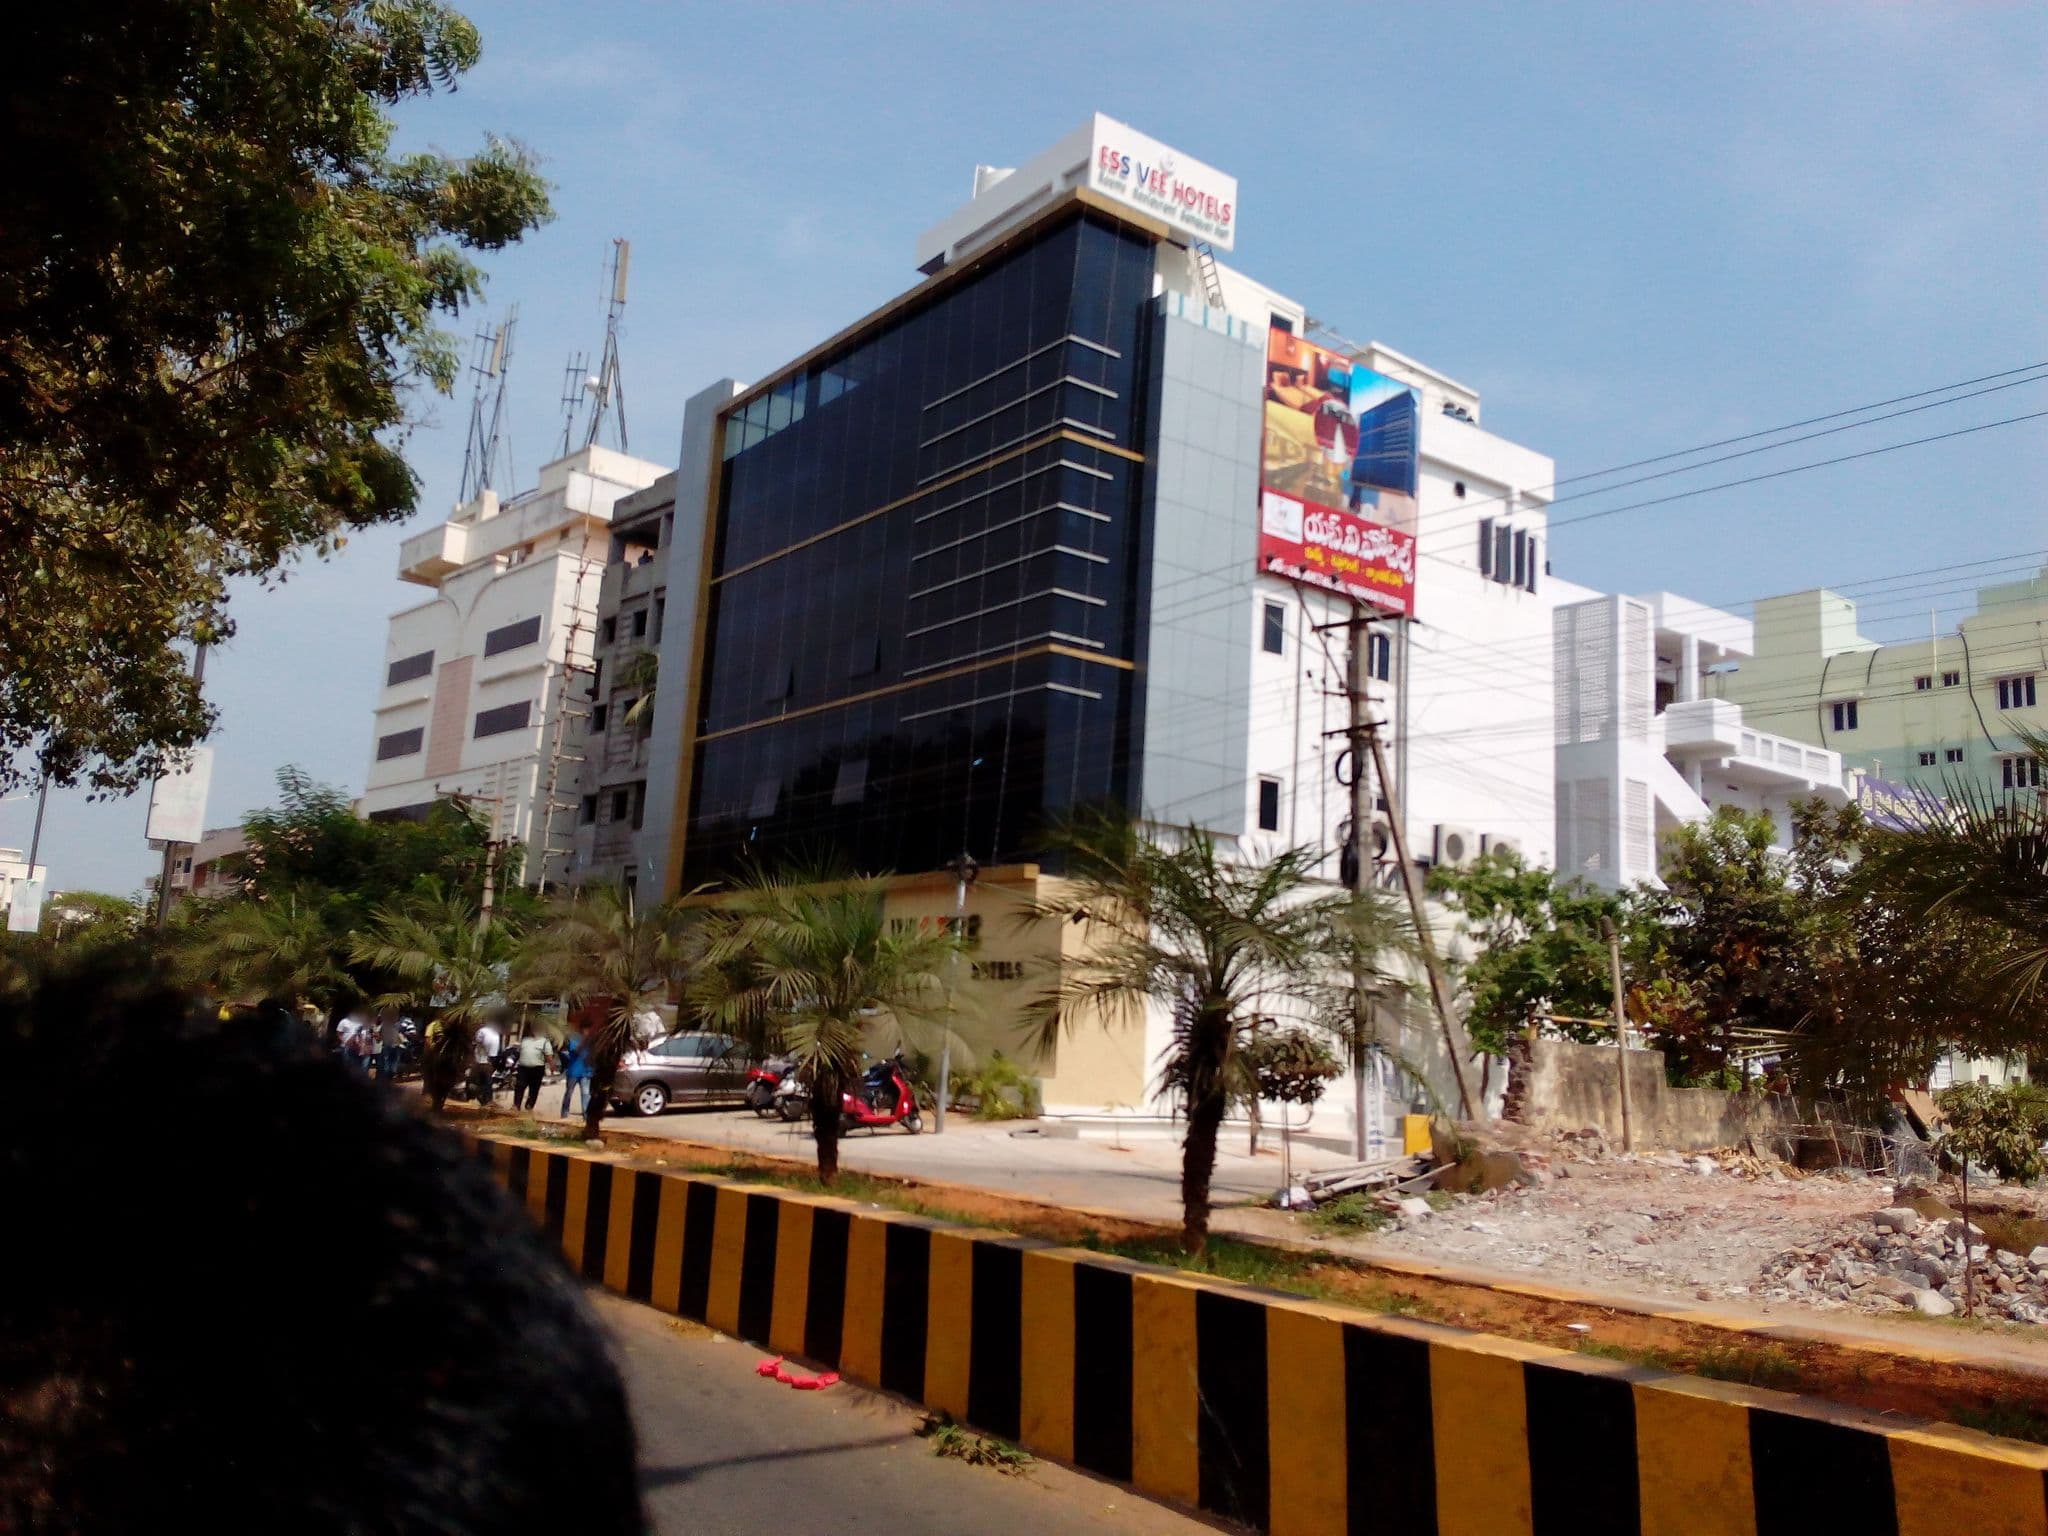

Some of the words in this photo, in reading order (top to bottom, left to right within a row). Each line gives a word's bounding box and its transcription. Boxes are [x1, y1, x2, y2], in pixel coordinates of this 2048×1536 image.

[1099, 145, 1131, 176] ESS
[1136, 161, 1168, 194] VEE
[1172, 178, 1232, 224] HOTELS
